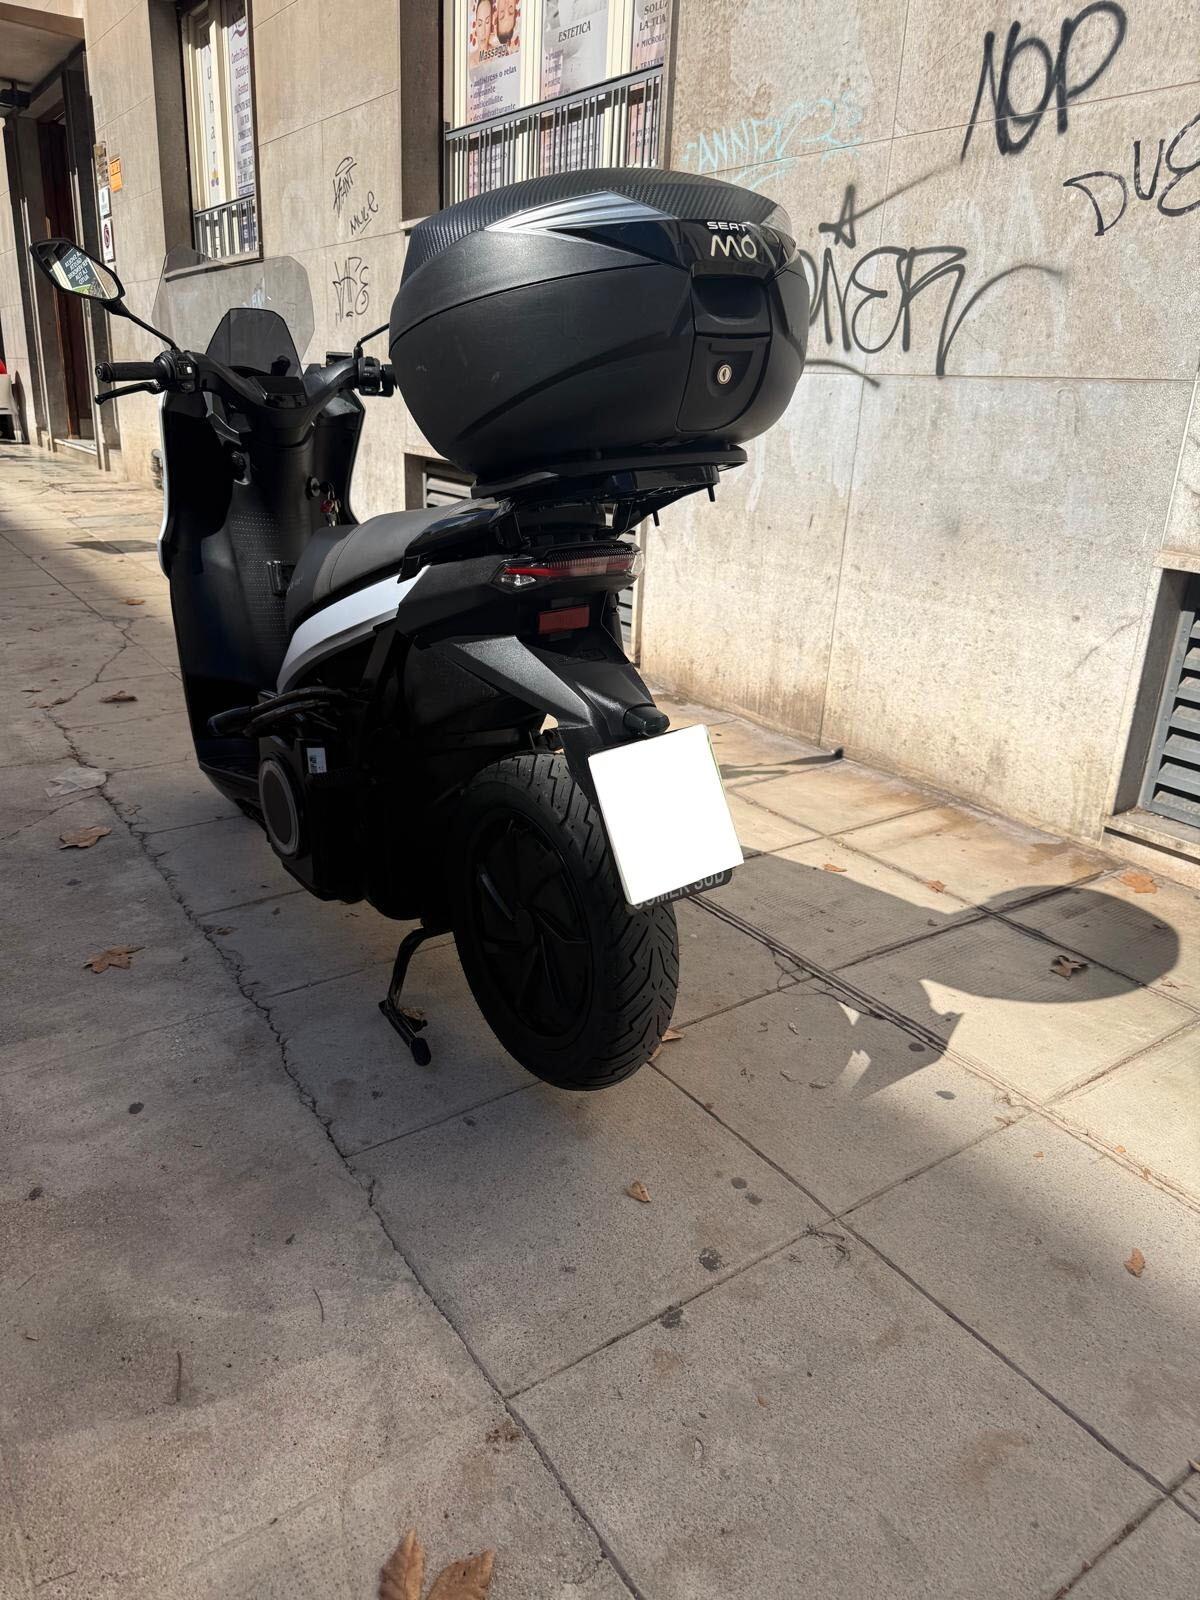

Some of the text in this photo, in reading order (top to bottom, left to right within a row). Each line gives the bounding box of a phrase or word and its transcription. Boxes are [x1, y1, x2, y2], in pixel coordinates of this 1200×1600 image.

[640, 14, 666, 31] LA TUA
[558, 21, 591, 42] ESTETICA
[504, 65, 517, 76] relax
[707, 221, 747, 232] SEAT
